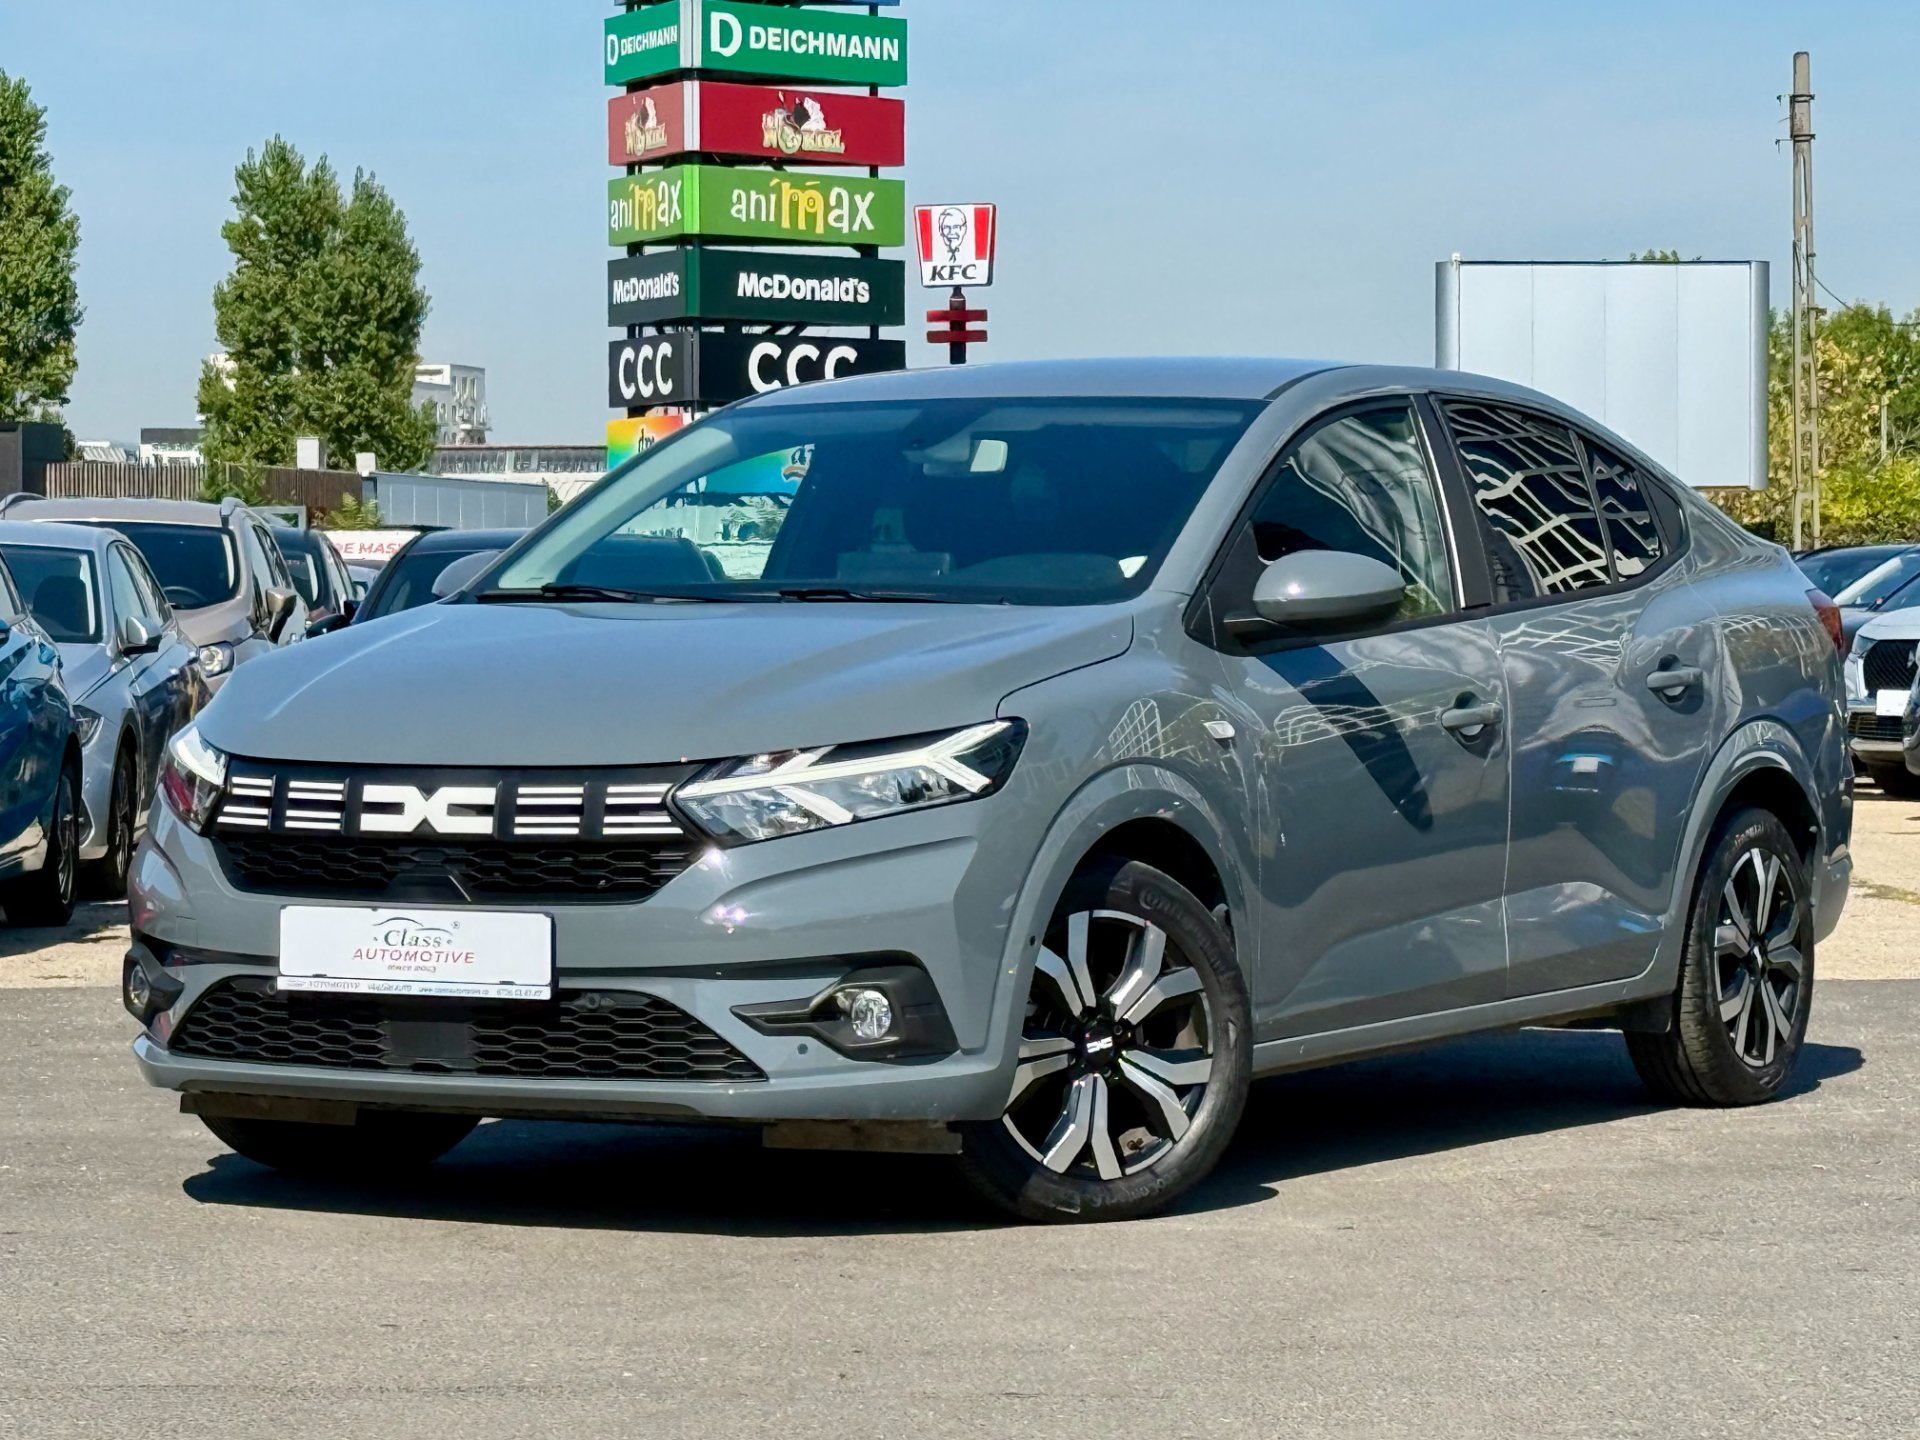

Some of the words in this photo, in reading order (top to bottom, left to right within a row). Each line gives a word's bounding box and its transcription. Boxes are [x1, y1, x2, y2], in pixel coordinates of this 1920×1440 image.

[620, 25, 678, 56] DEICHMANN
[710, 12, 743, 57] D
[749, 26, 899, 62] DEICHMANN
[611, 178, 682, 231] animax
[731, 178, 876, 234] animax
[613, 272, 680, 305] McDonald's
[737, 272, 870, 304] McDonald's
[930, 264, 977, 281] KFC
[618, 342, 674, 400] CCC
[748, 342, 858, 393] CCC
[383, 928, 442, 948] Class
[352, 948, 475, 964] AUTOMOTIVE
